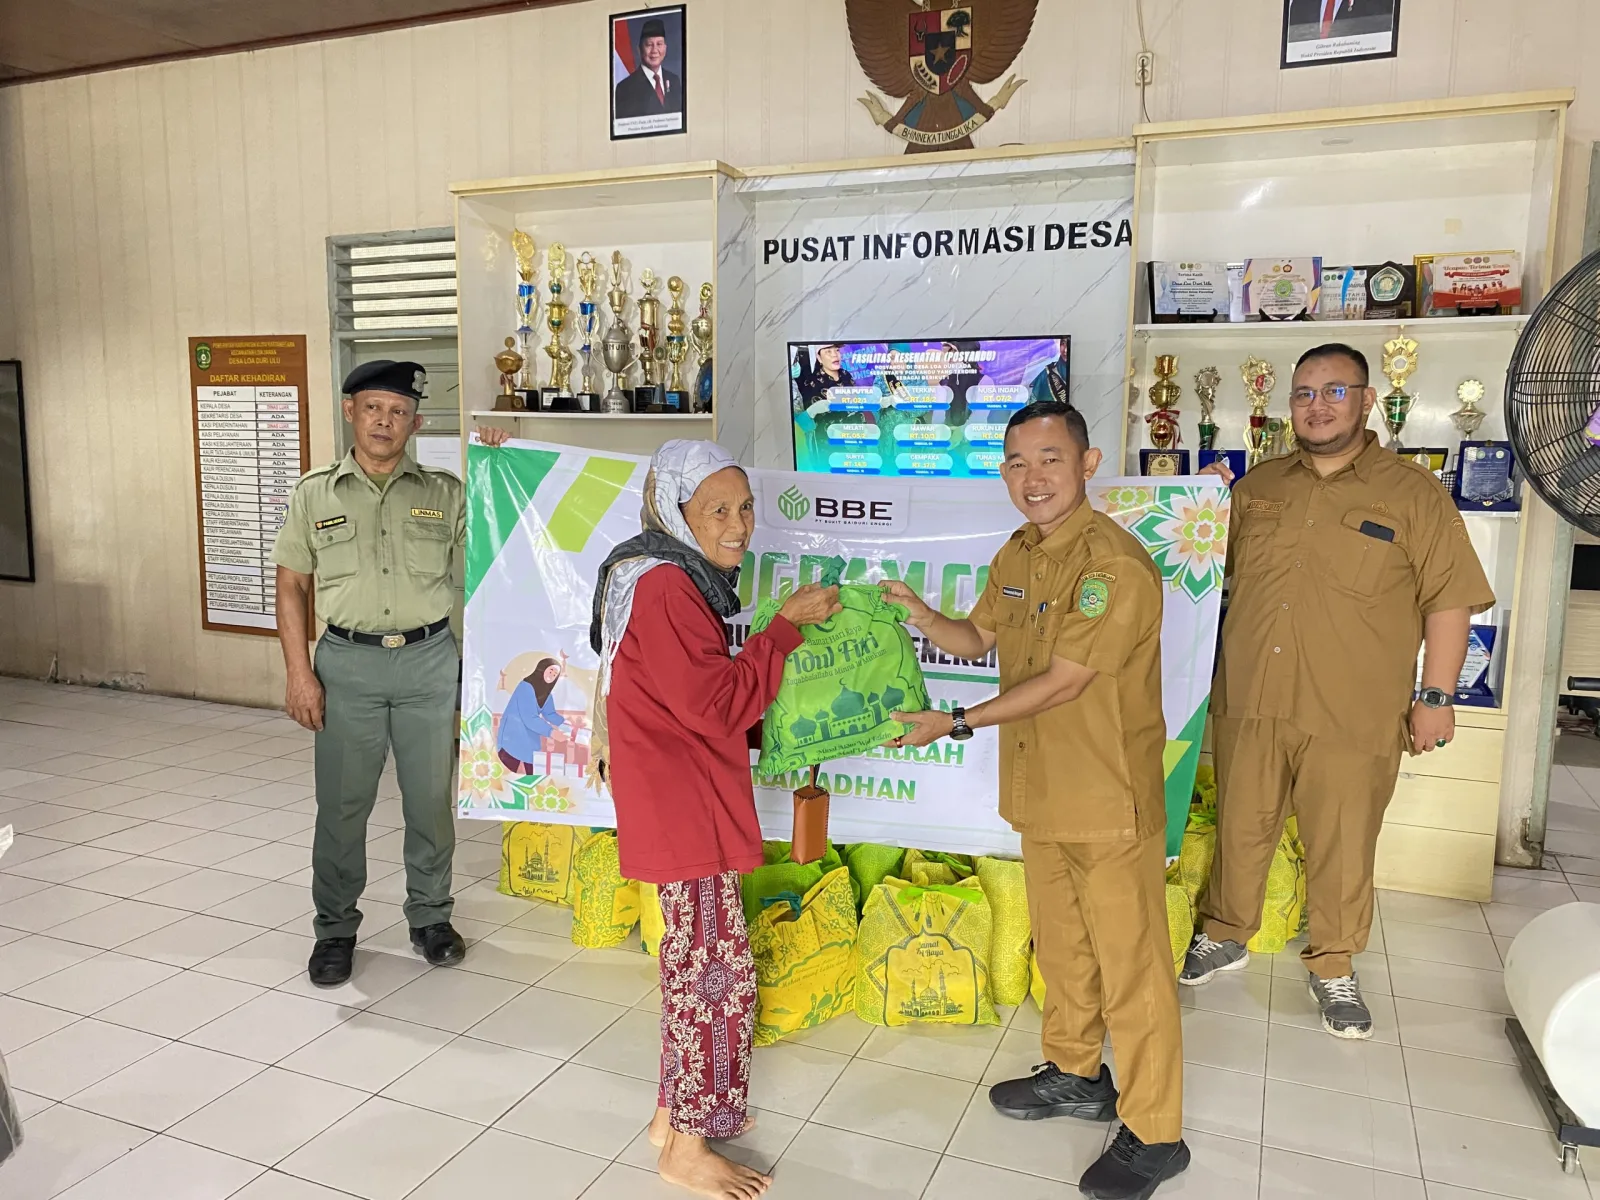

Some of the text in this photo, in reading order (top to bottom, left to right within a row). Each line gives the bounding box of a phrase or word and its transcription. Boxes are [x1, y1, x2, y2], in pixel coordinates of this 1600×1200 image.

[902, 120, 978, 143] BHINNEKA TUNGGAL IKA
[764, 219, 1132, 264] PUSAT INFORMASI DESA
[852, 353, 892, 364] FASILITAS
[895, 352, 941, 362] KESEHATAN
[241, 374, 286, 382] KEHADIRAN
[816, 497, 892, 520] BBE
[802, 624, 862, 647] Selamat Hari Raya
